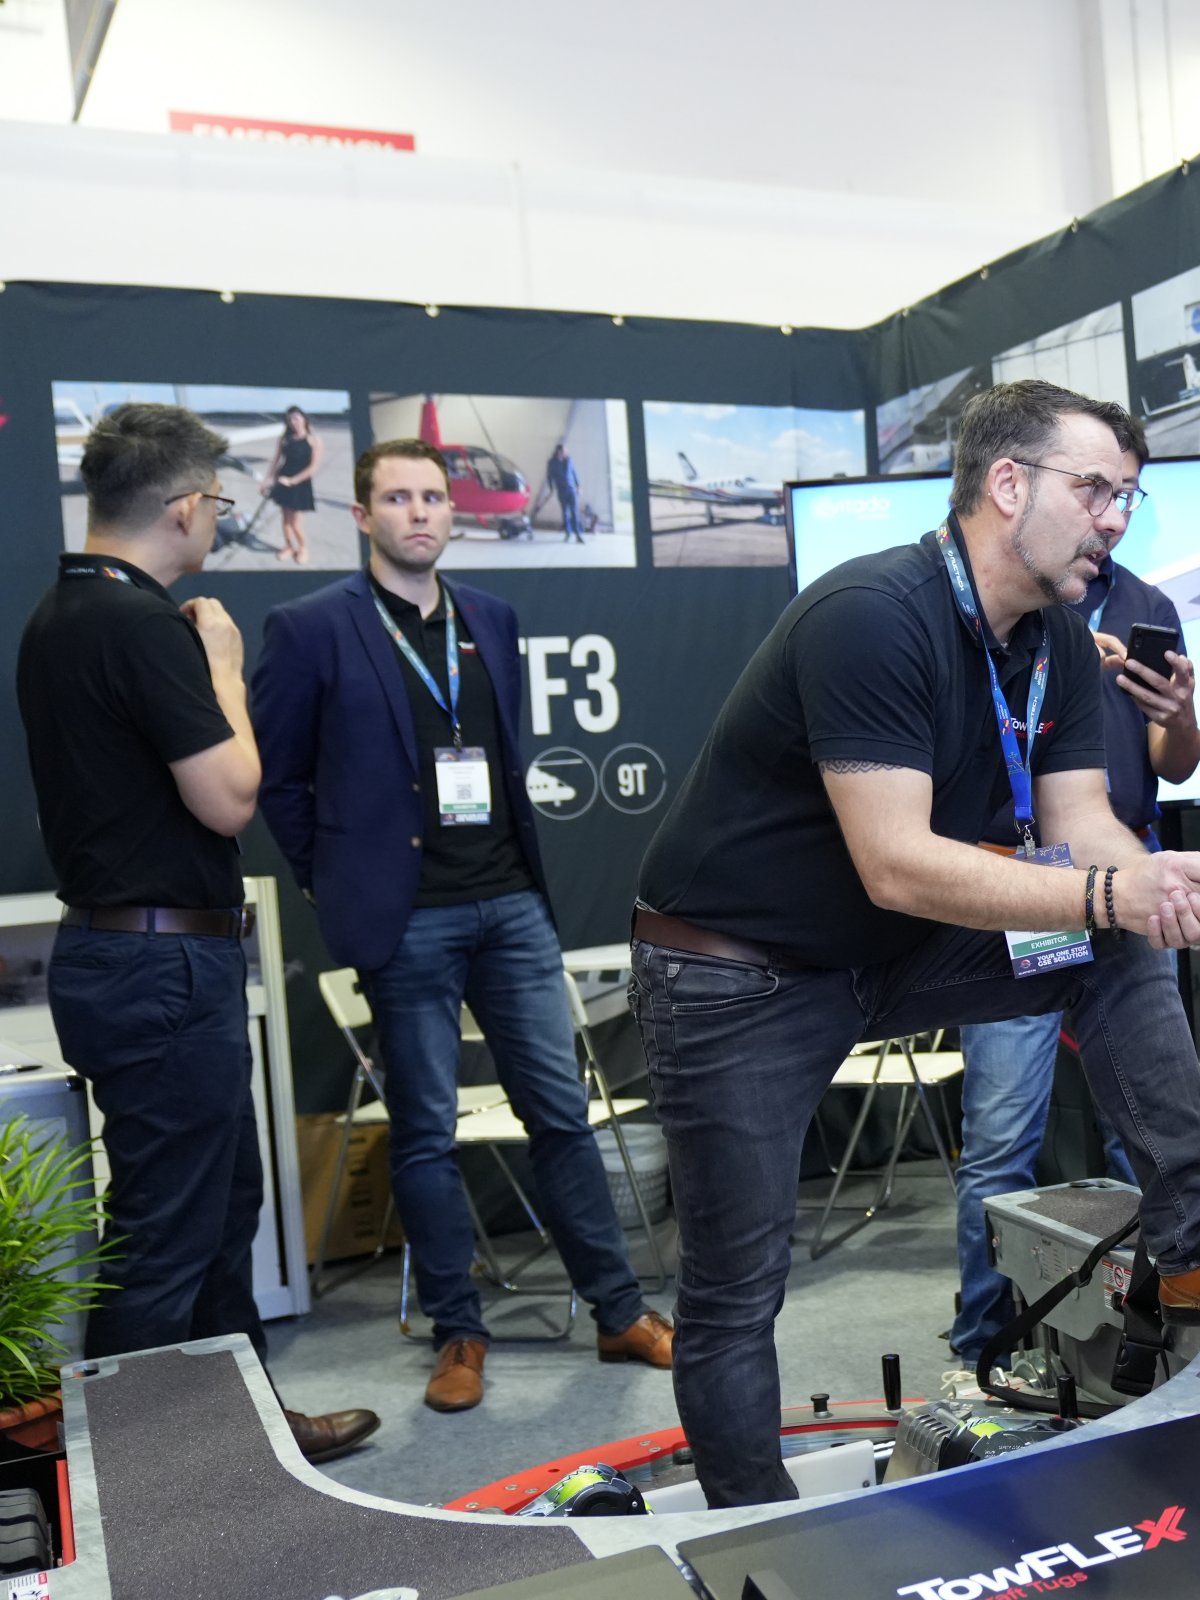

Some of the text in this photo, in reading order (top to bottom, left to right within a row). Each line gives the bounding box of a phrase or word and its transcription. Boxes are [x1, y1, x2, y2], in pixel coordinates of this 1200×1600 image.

[949, 555, 966, 592] NUCTECH
[518, 634, 620, 735] F3
[617, 763, 647, 797] 9T
[1031, 935, 1068, 950] EXHIBITOR
[1071, 945, 1087, 953] STOP
[1037, 950, 1088, 967] GSE SOLUTION
[1026, 1572, 1089, 1594] Tugs
